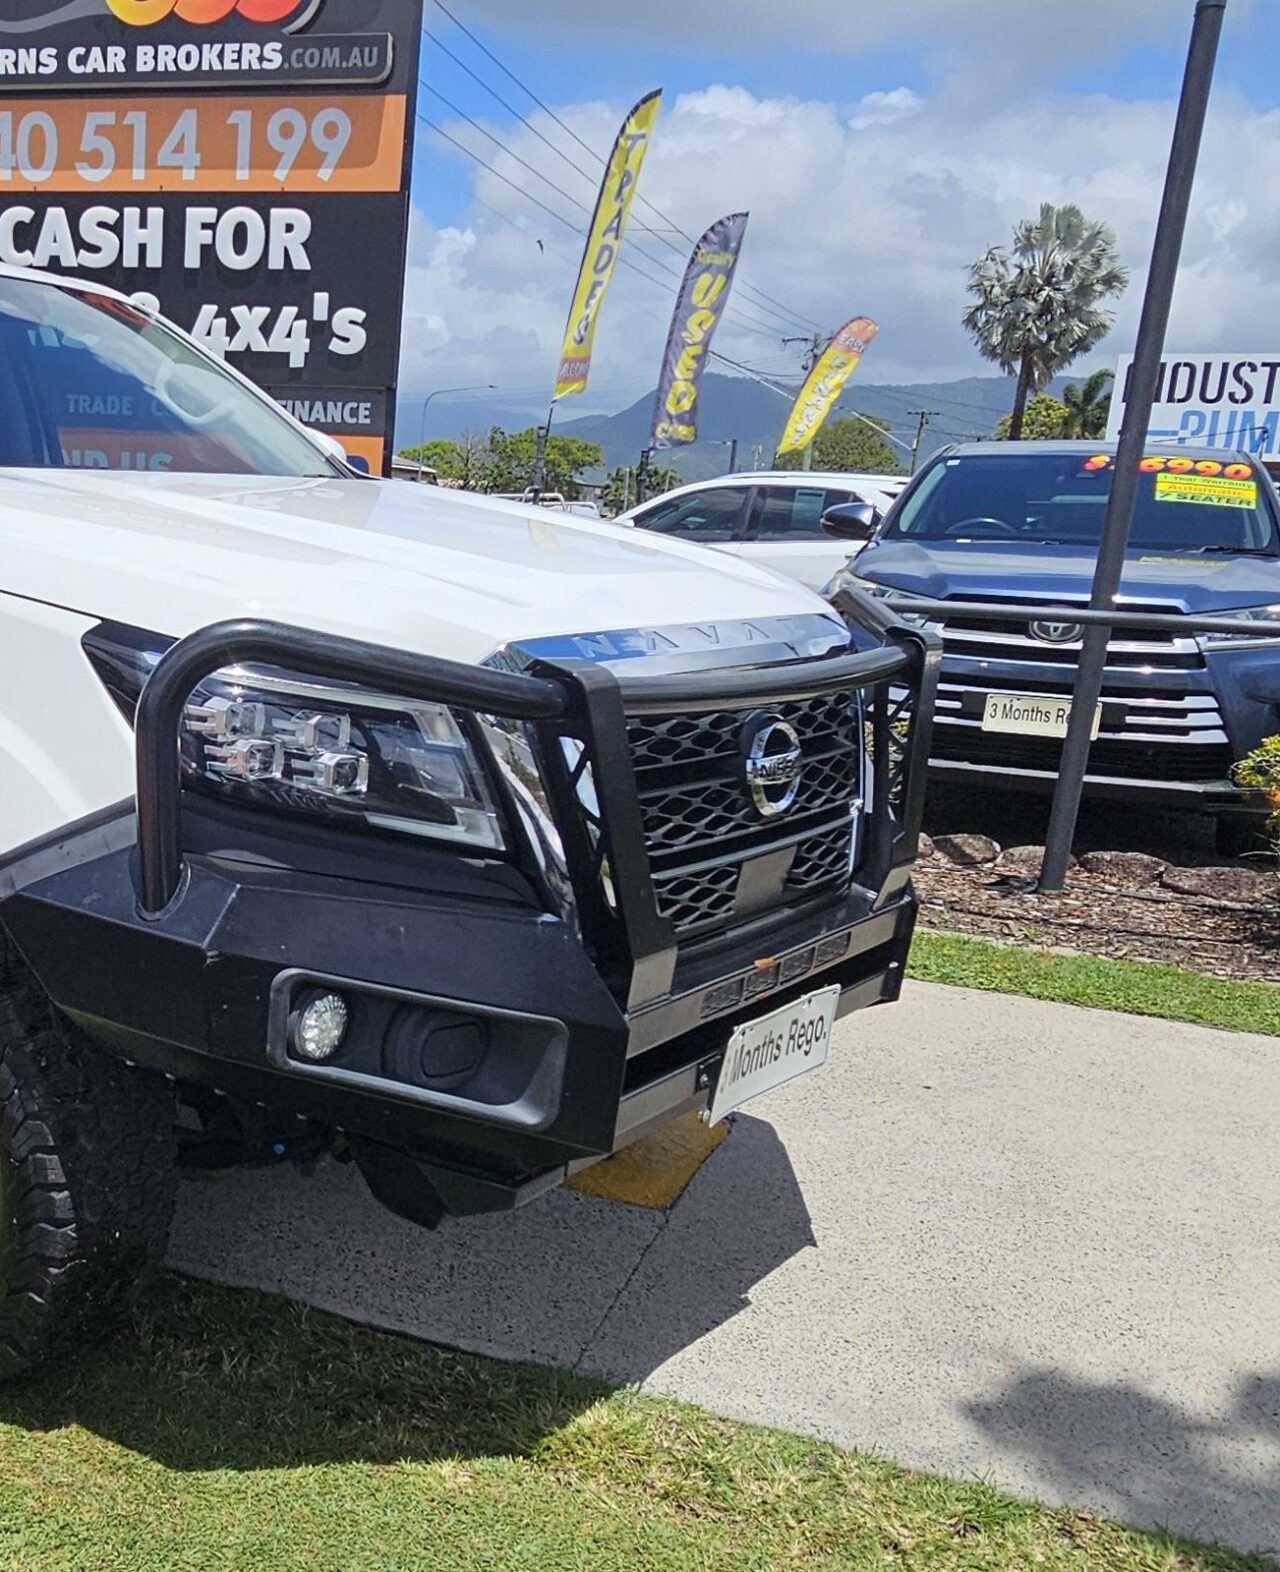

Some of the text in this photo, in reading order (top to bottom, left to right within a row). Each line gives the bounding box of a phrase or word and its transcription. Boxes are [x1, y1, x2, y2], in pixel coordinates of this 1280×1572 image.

[67, 45, 126, 75] CAR
[135, 42, 379, 73] BROKERS.COM.AU
[74, 109, 201, 182] 514
[226, 107, 352, 182] 199
[183, 207, 312, 271] FOR
[65, 394, 134, 417] TRADE
[1177, 409, 1280, 454] PUM
[1176, 493, 1253, 507] SEATER
[989, 702, 998, 719] 3
[1001, 703, 1052, 723] Months
[728, 1030, 784, 1087] Months
[785, 1014, 827, 1057] Rego.
